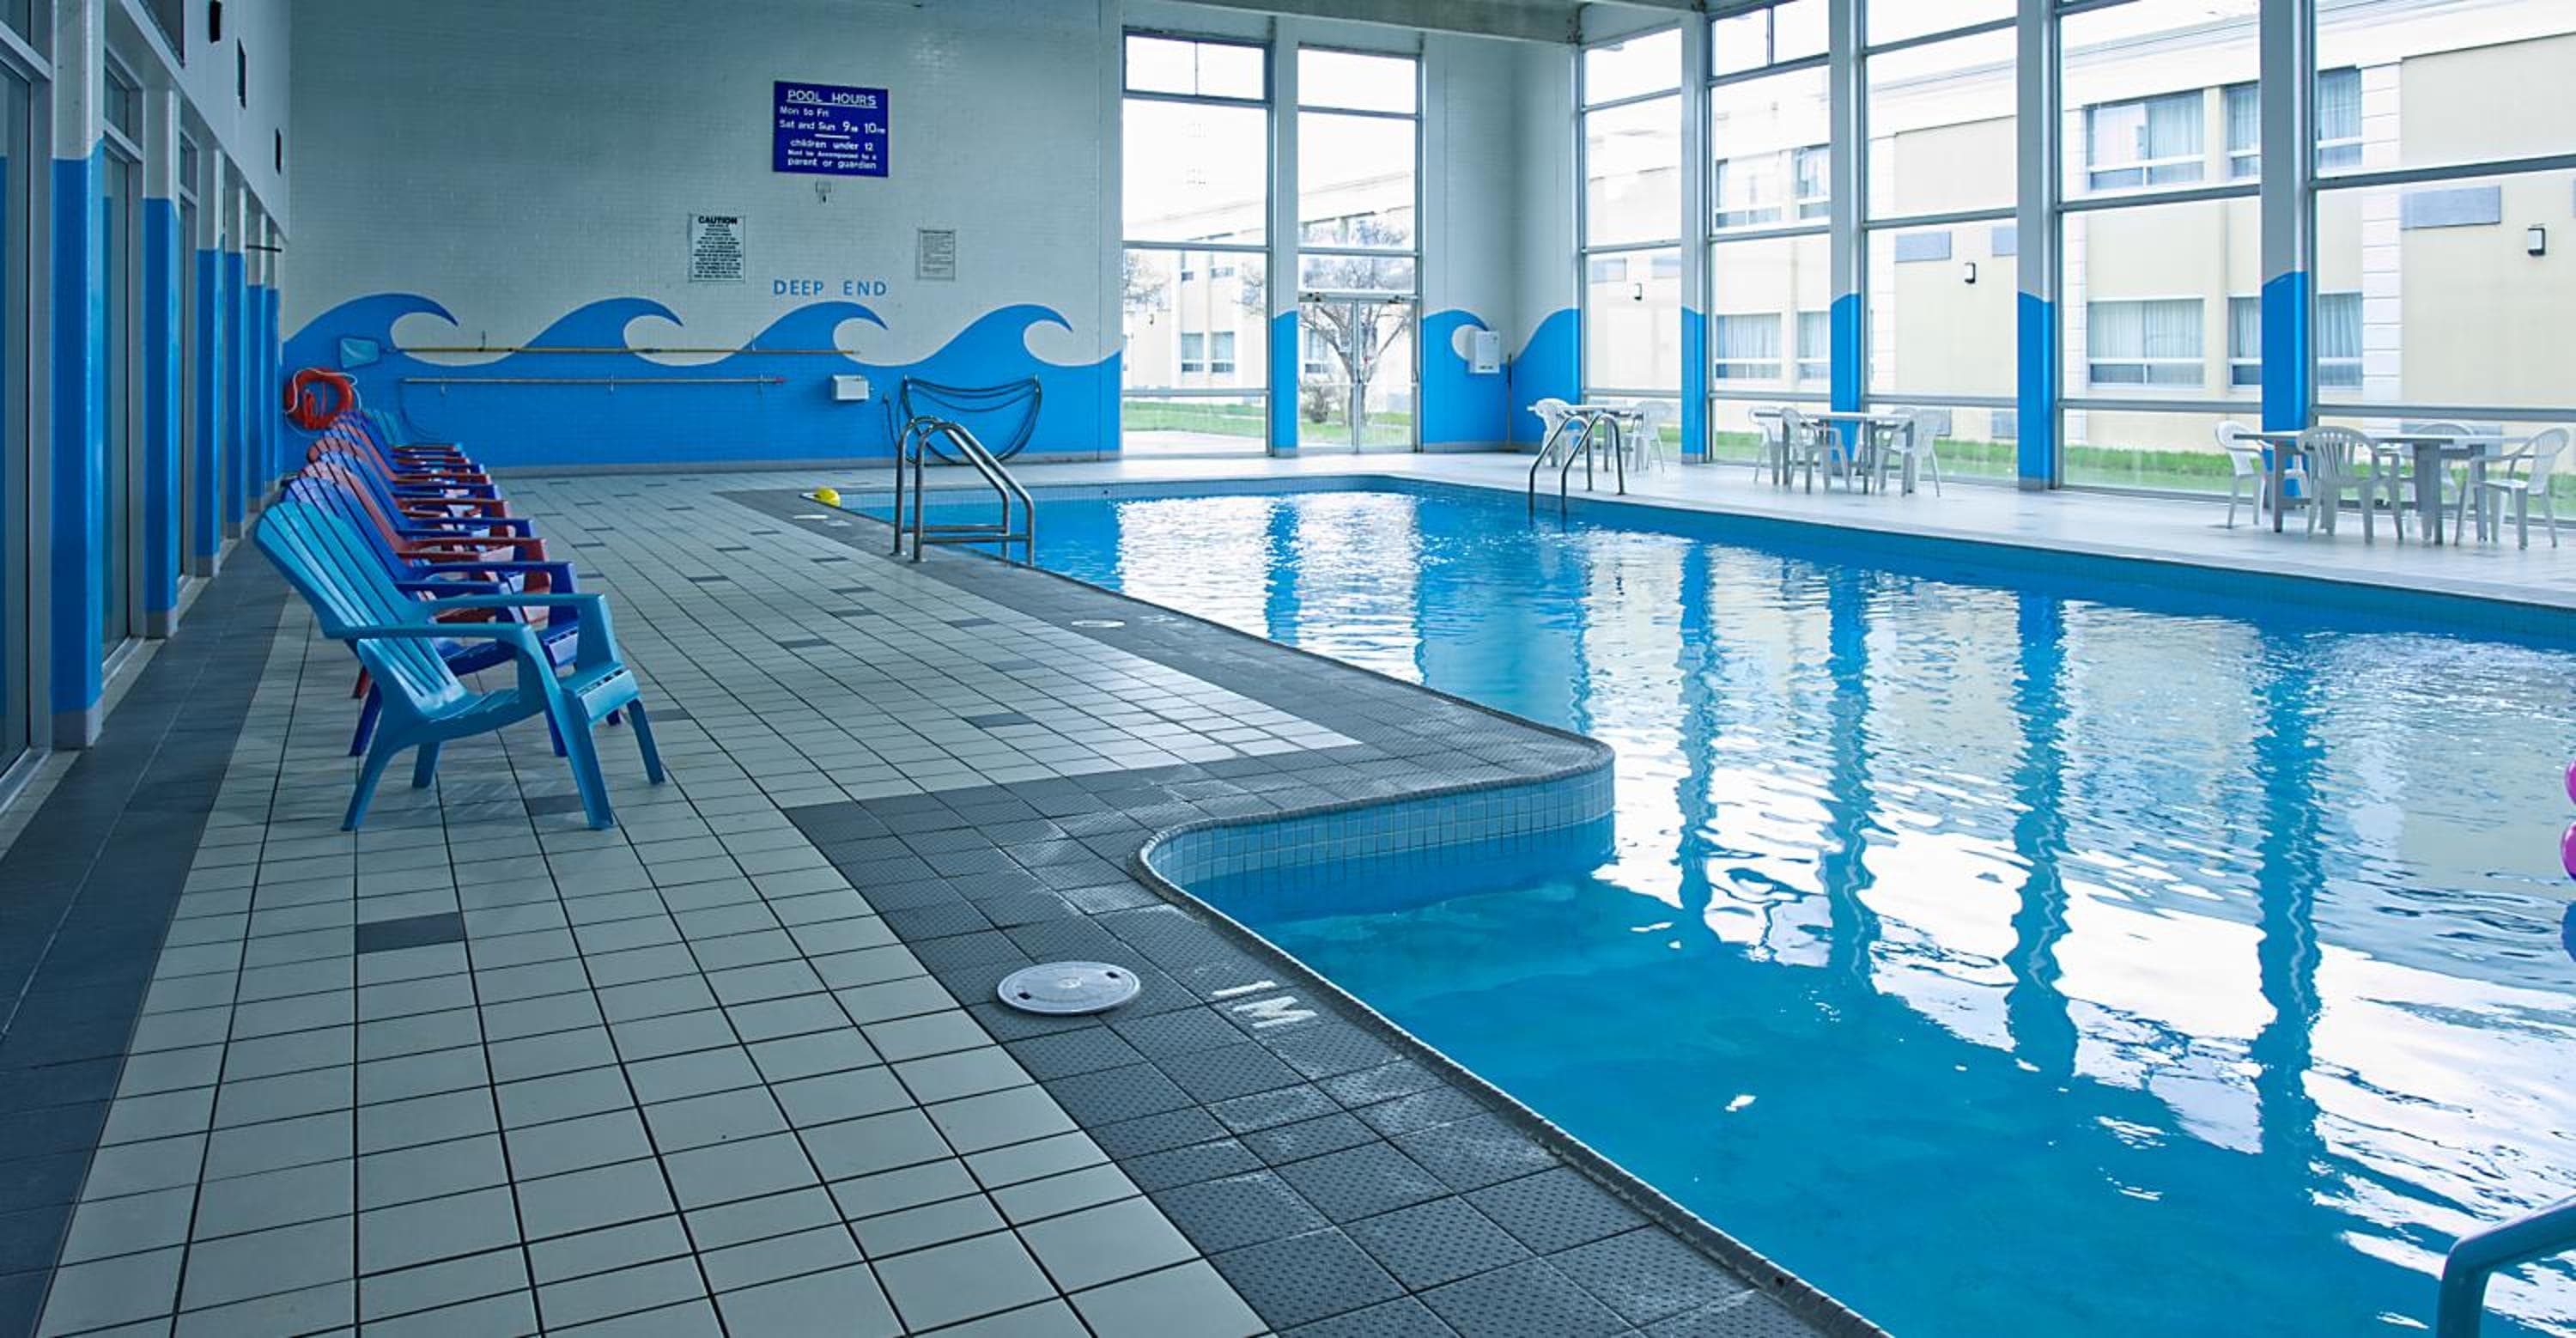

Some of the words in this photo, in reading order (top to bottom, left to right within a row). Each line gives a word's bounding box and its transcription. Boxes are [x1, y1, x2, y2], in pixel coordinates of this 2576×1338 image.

[787, 89, 823, 102] POOL
[831, 92, 877, 106] HOURS
[779, 106, 799, 115] Mon
[803, 107, 814, 116] to
[817, 107, 829, 117] Fri
[779, 119, 795, 128] Sat
[798, 121, 815, 130] and
[817, 121, 835, 131] Sun
[790, 138, 827, 149] children
[832, 140, 860, 150] under
[865, 143, 873, 151] 12
[822, 159, 833, 167] or
[837, 161, 877, 169] guardian
[698, 216, 738, 225] CAUTION
[773, 279, 824, 295] DEEP
[843, 280, 887, 296] END
